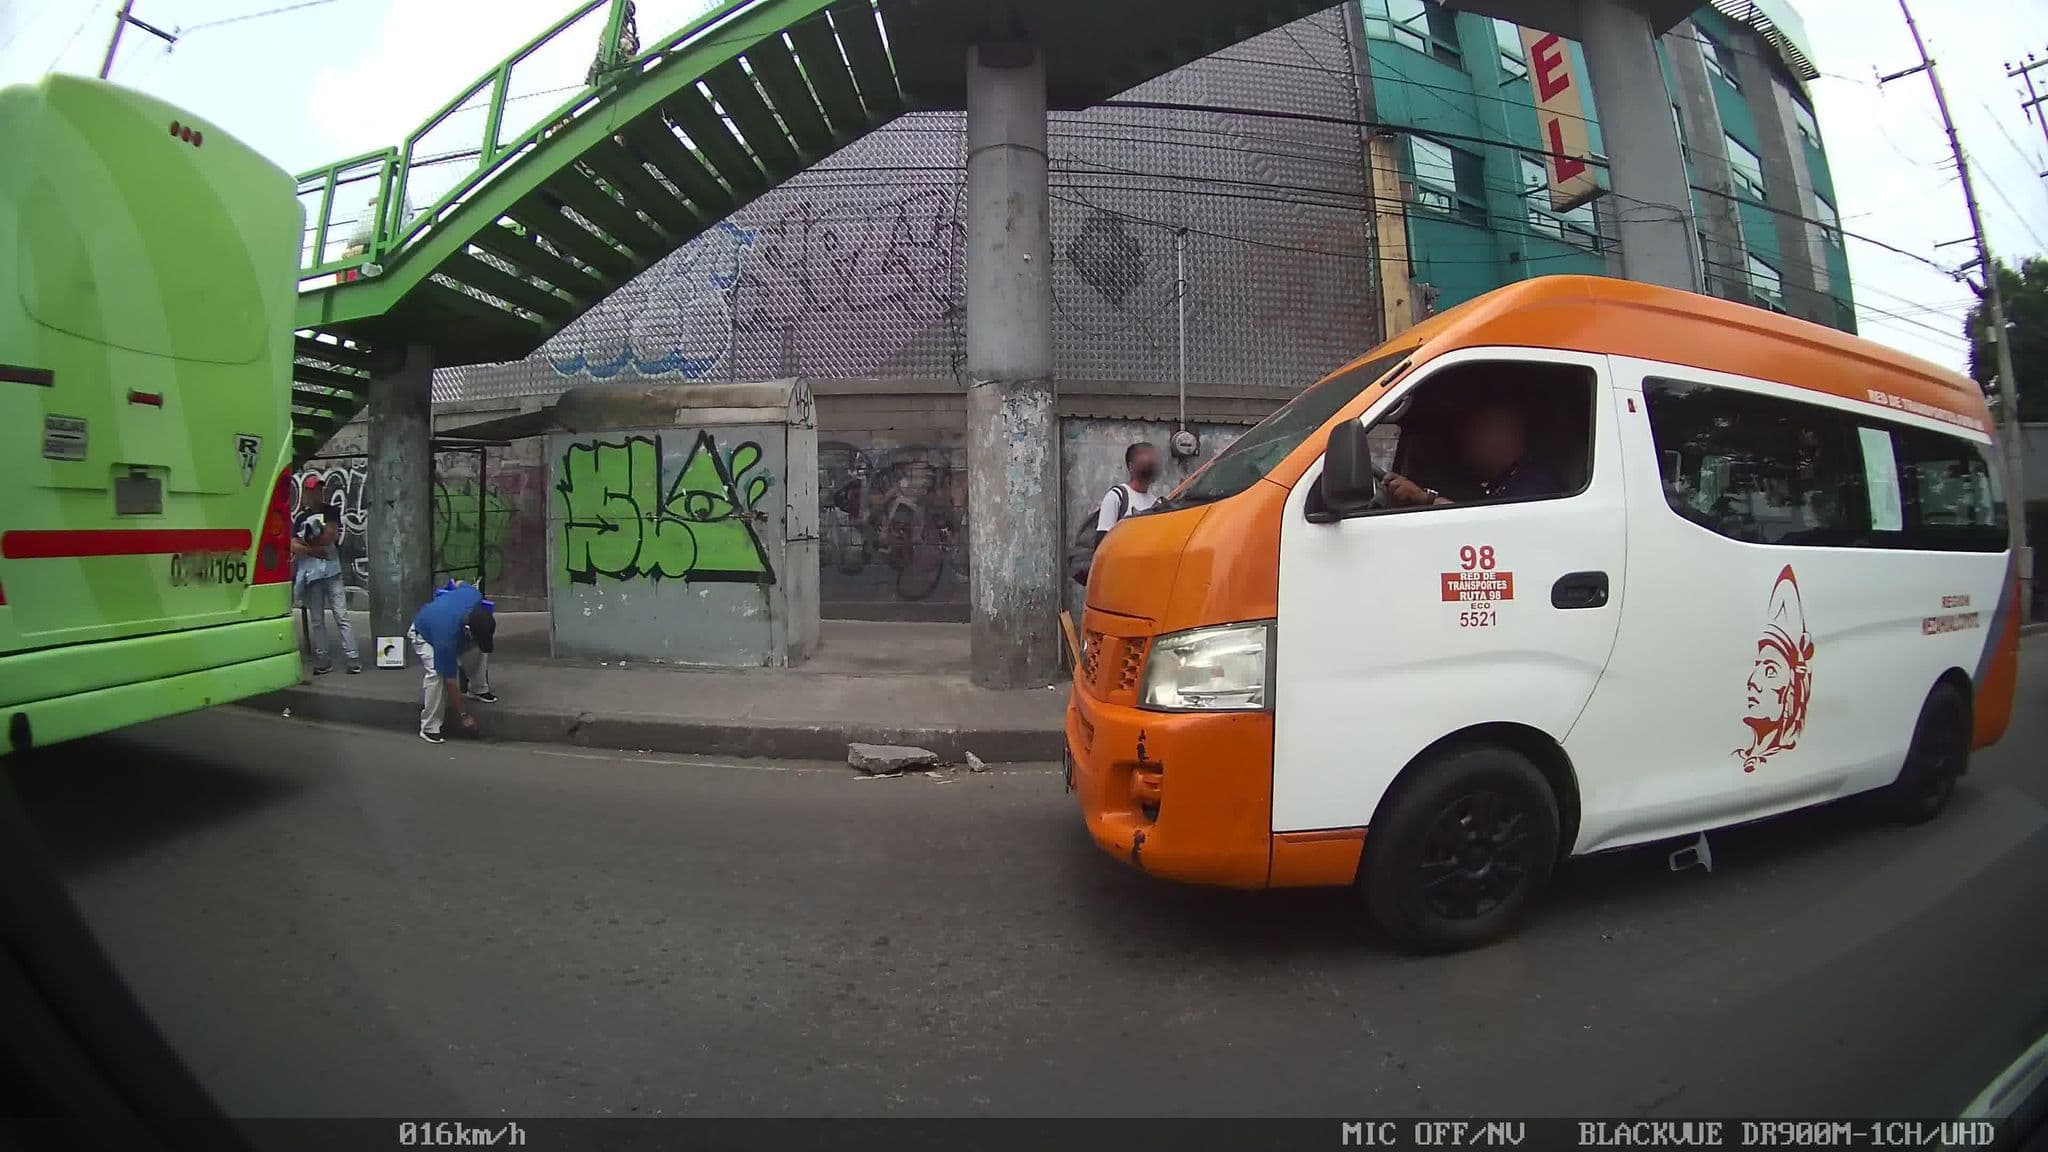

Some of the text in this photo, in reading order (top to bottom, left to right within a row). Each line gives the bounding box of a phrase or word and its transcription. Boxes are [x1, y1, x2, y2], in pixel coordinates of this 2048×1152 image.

[239, 438, 257, 453] R
[1459, 545, 1496, 571] 98
[1460, 572, 1496, 580] RED DE
[1447, 580, 1507, 591] TRANSPORTES
[1460, 591, 1501, 601] RUTA 98
[1460, 611, 1496, 627] 5521
